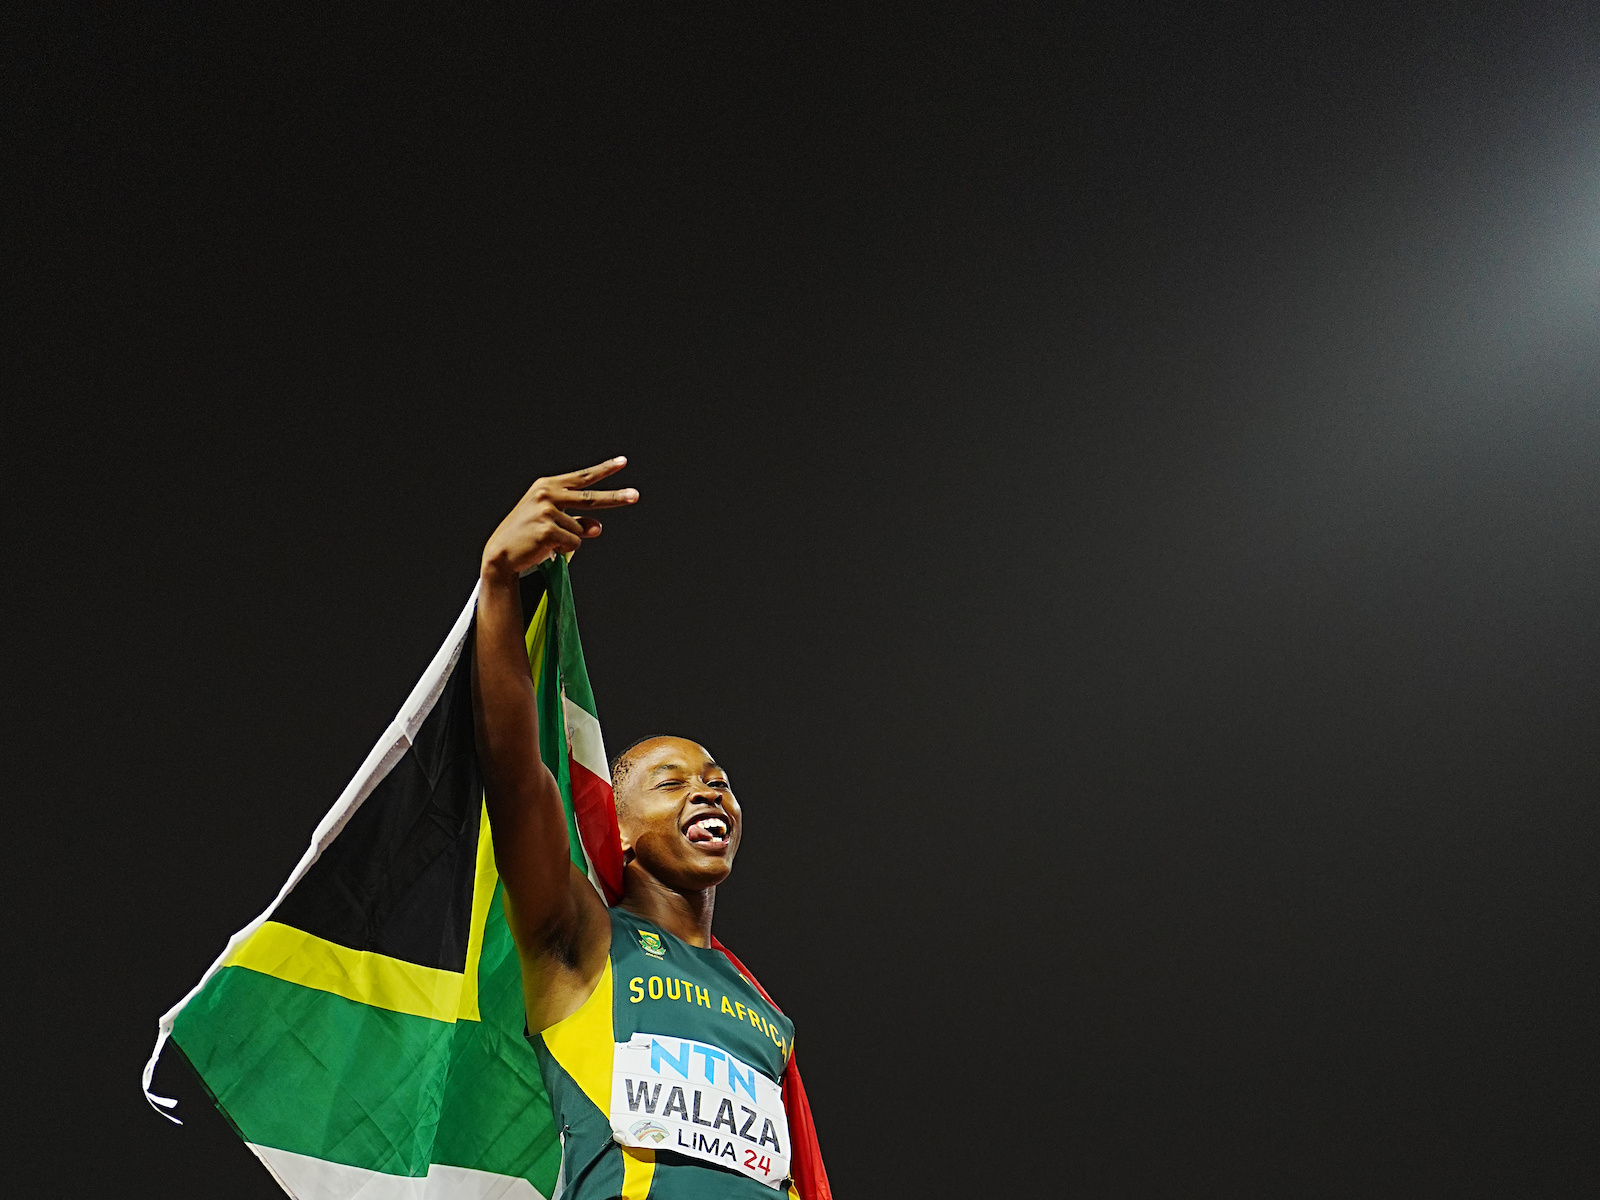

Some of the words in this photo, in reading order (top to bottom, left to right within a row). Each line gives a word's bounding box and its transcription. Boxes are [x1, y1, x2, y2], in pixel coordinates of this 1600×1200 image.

[629, 976, 711, 1009] SOUTH
[650, 1038, 757, 1104] NTN
[624, 1079, 781, 1154] WALAZA
[743, 1149, 771, 1177] 24
